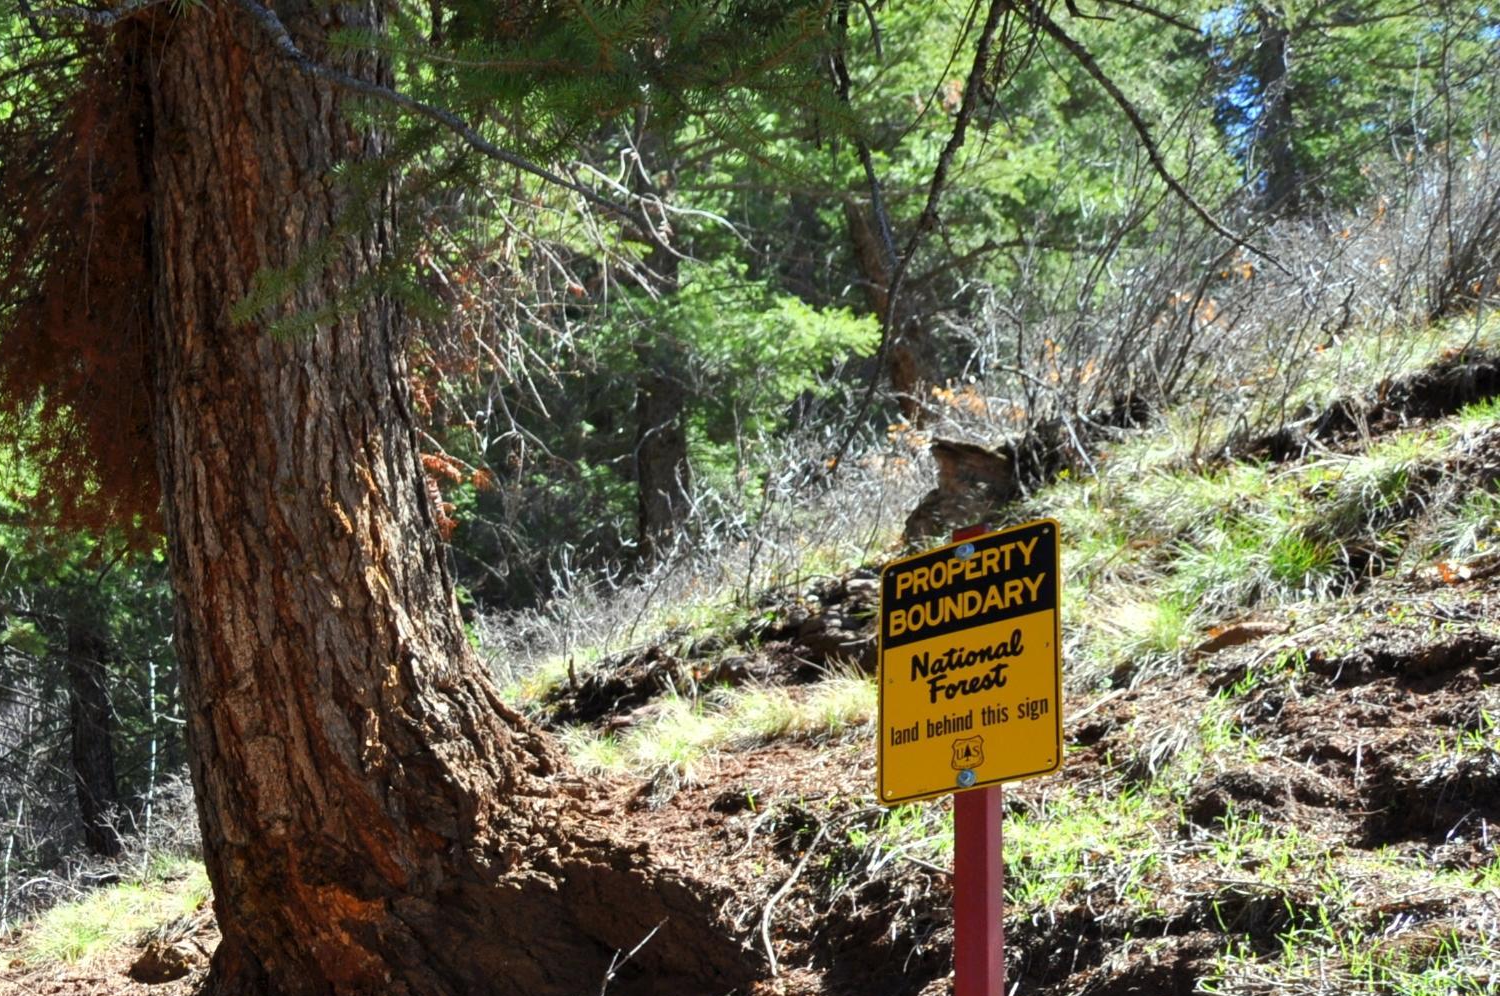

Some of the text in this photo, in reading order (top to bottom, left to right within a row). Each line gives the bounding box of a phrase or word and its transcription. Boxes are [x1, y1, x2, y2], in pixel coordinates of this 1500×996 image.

[895, 536, 1038, 599] PROPERTY
[888, 572, 1046, 637] BOUNDARY
[911, 628, 1024, 681] National
[927, 663, 1009, 703] Forest
[891, 698, 1049, 747] land behind this sign
